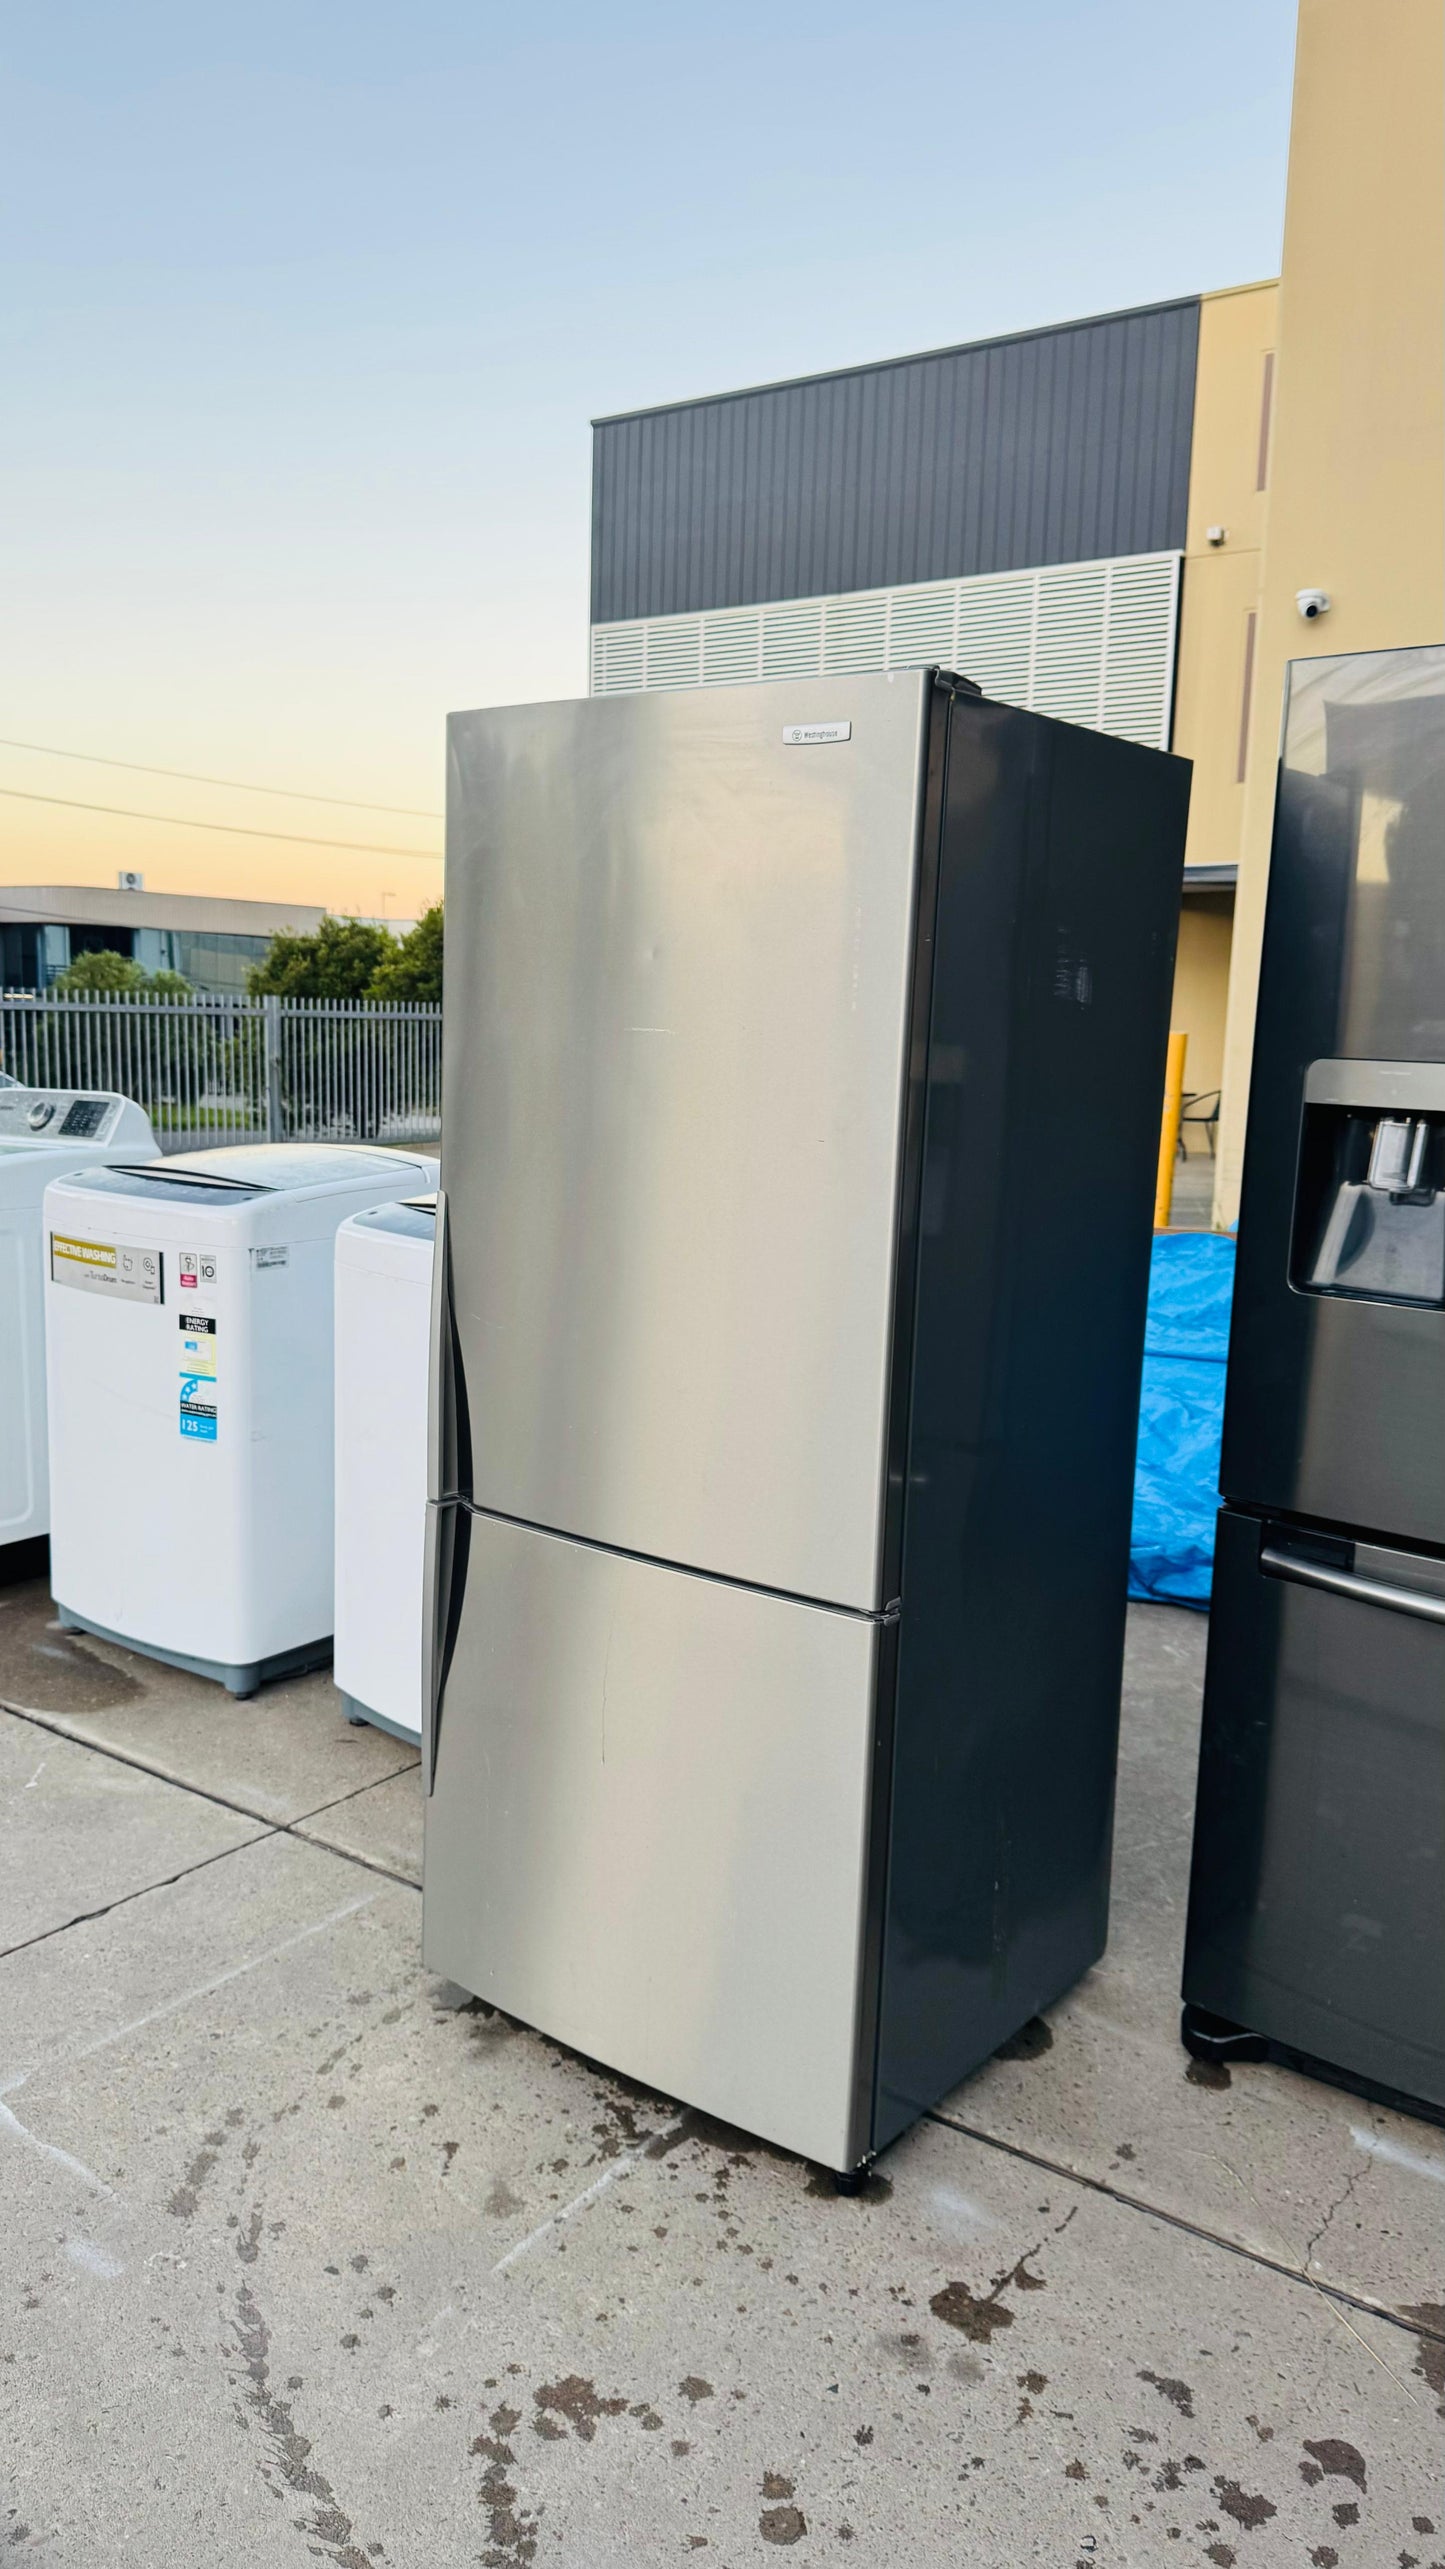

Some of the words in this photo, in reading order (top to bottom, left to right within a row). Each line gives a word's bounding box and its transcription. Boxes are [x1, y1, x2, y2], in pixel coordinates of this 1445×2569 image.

[53, 1240, 82, 1257] EFFECTIVE
[82, 1247, 116, 1264] WASHING
[185, 1317, 209, 1326] ENERGY
[186, 1324, 209, 1333] RATING
[181, 1403, 197, 1411] WATER
[197, 1404, 217, 1414] RATING
[182, 1419, 198, 1432] 125
